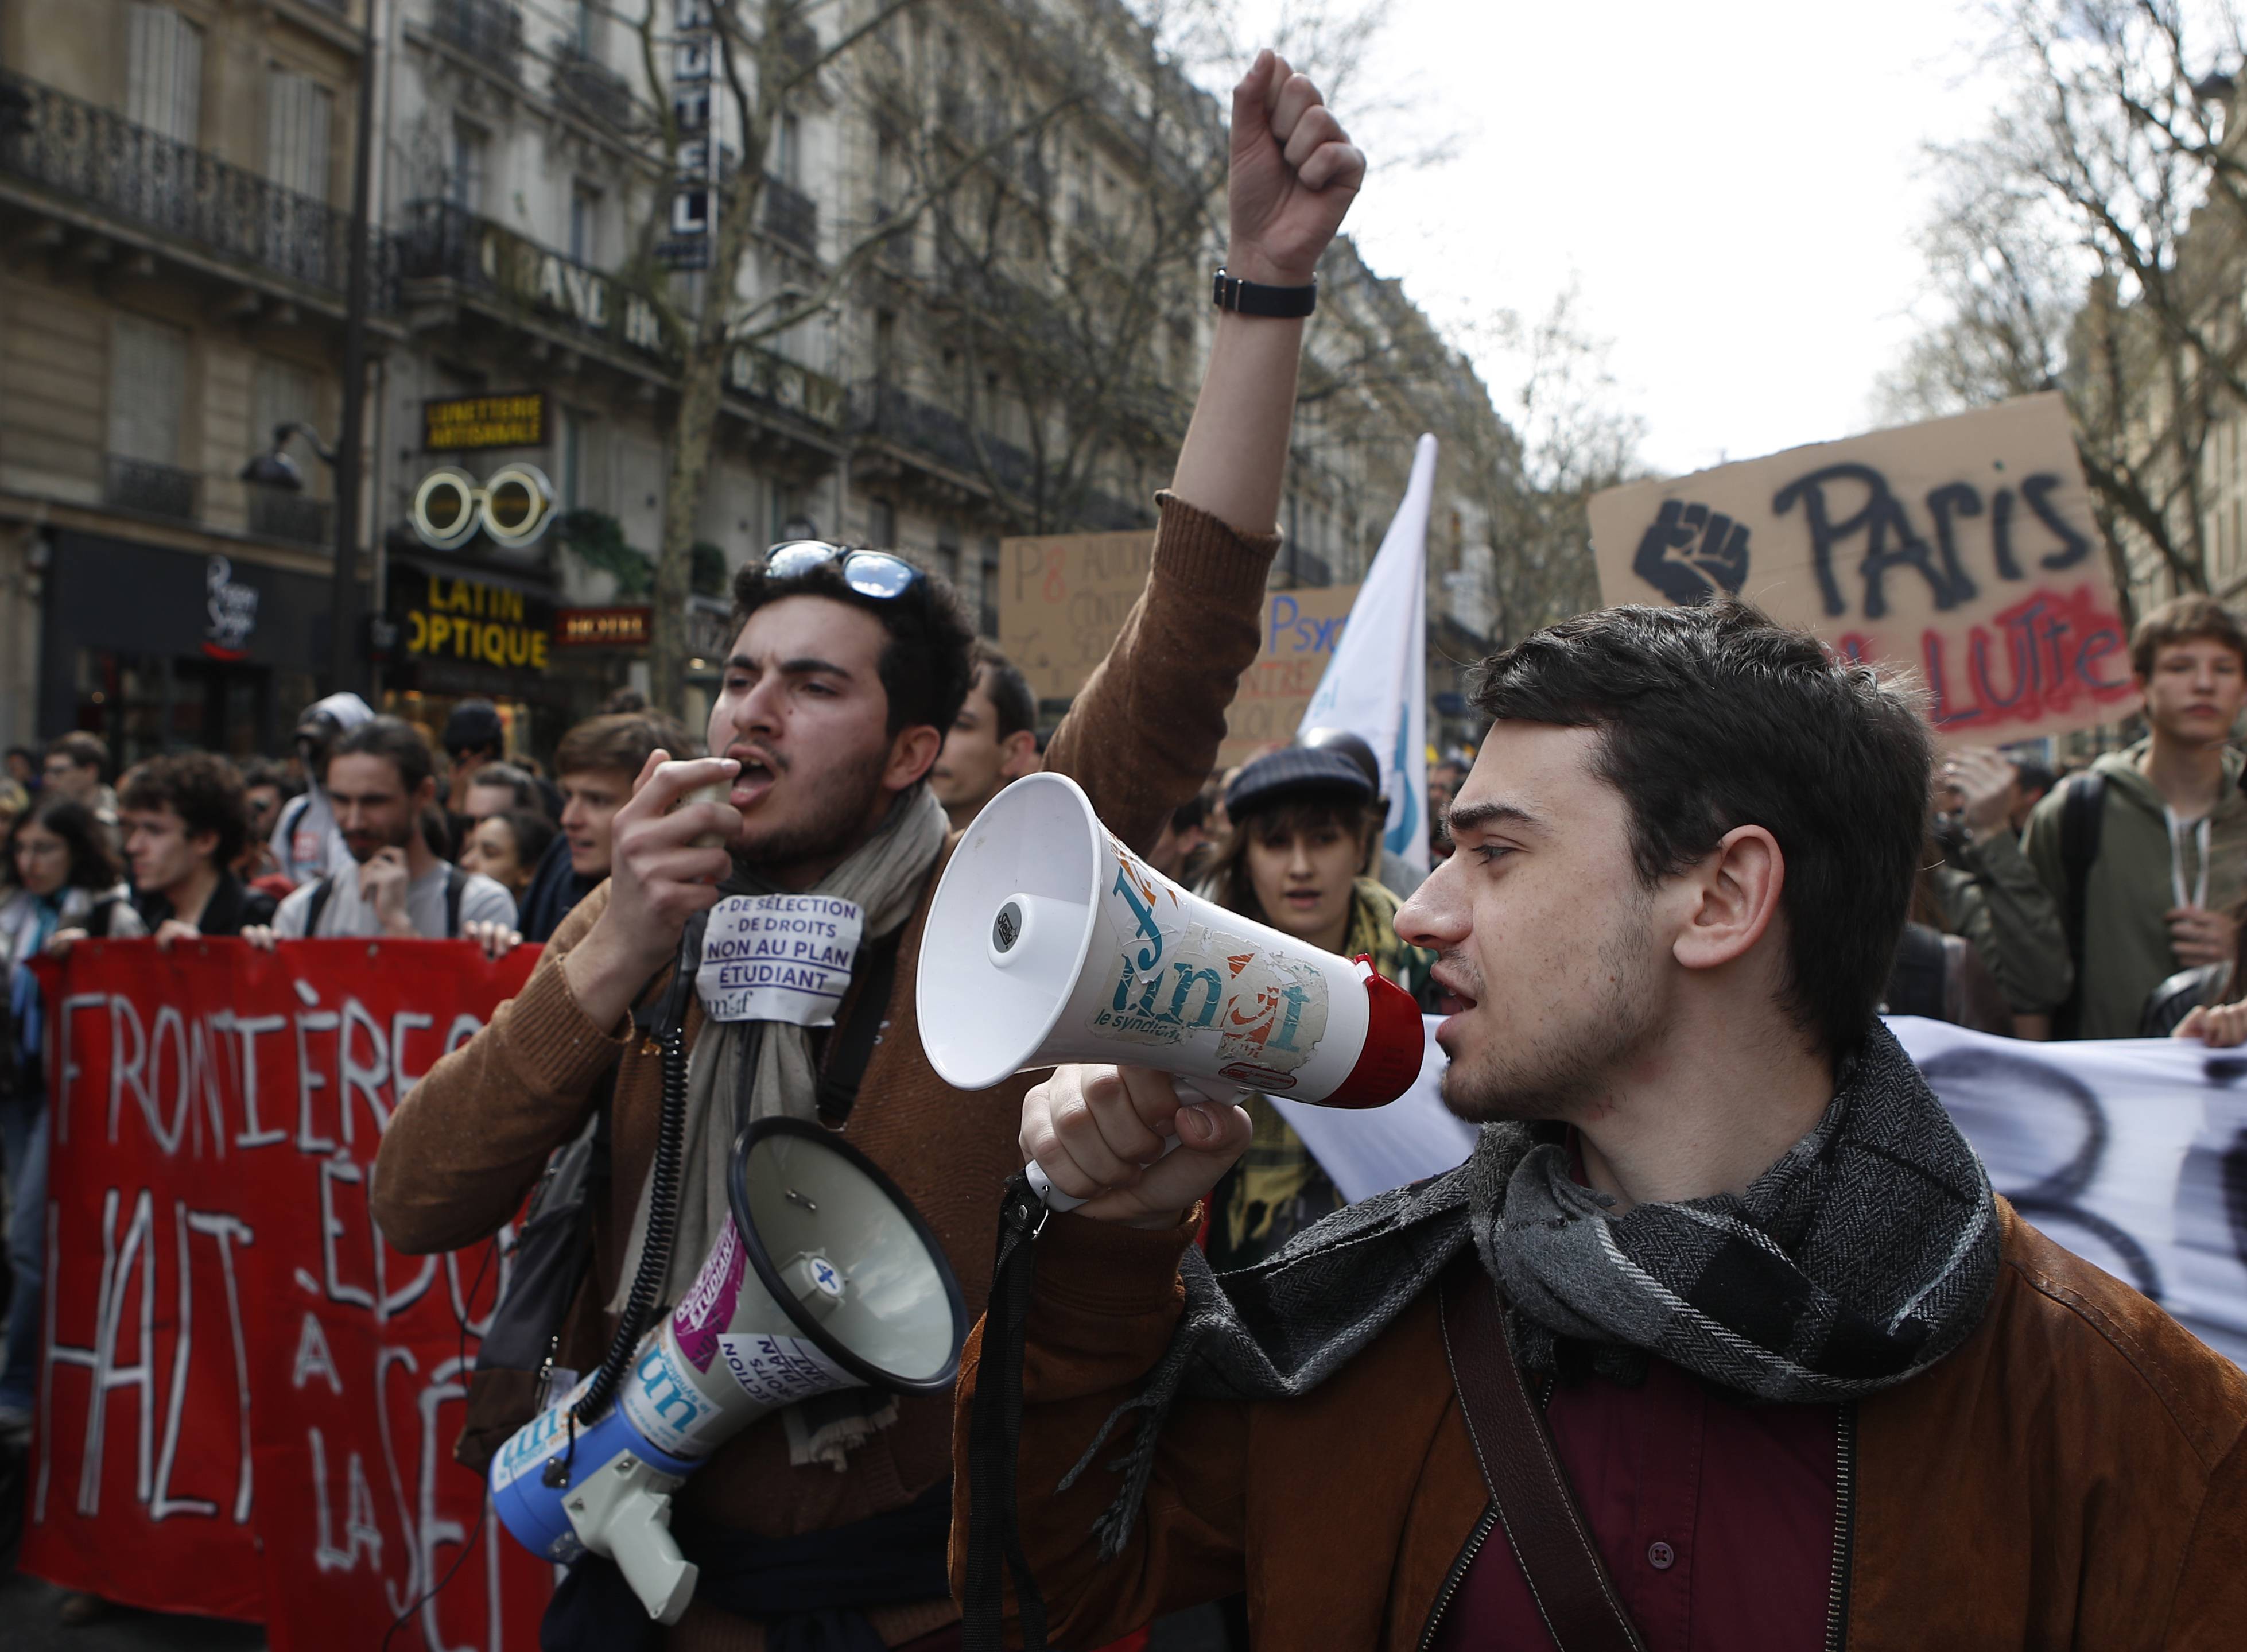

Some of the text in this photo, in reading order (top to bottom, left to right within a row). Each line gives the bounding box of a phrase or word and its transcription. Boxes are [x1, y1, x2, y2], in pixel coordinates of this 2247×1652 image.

[428, 575, 523, 622] LATIN
[729, 898, 751, 912] DE
[756, 896, 856, 920] SÉLECTION
[739, 918, 760, 933] DE
[764, 917, 836, 939] DROITS
[707, 939, 849, 967] NON AU PLAN
[1093, 1008, 1112, 1026] le
[308, 1425, 383, 1574] LA
